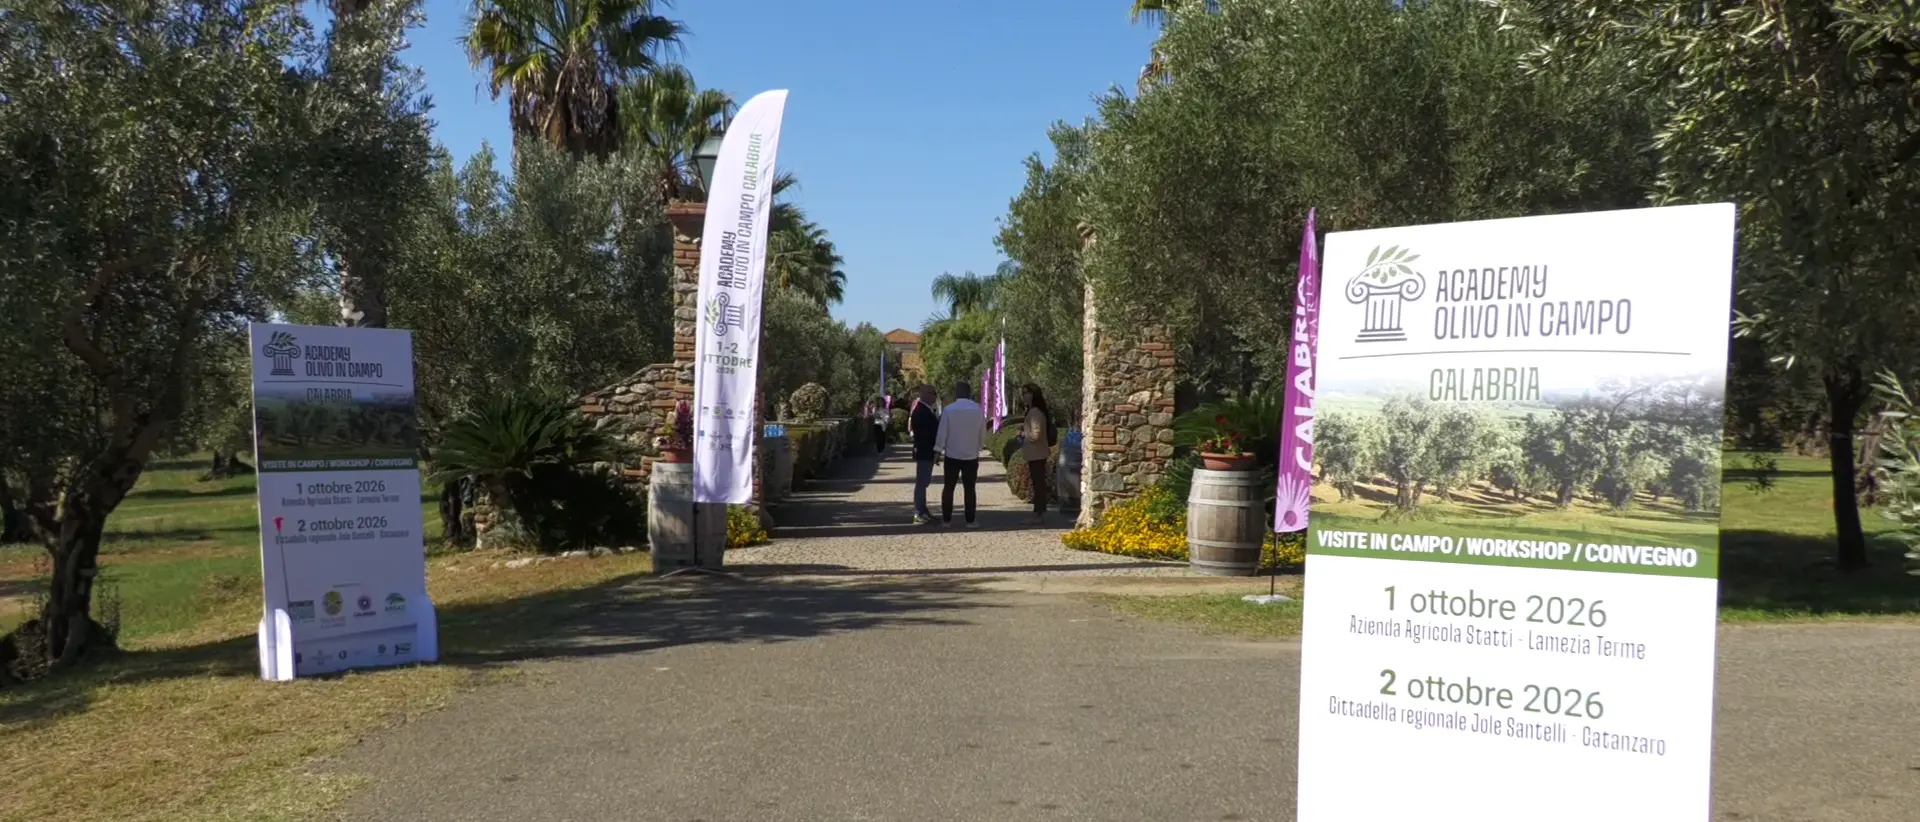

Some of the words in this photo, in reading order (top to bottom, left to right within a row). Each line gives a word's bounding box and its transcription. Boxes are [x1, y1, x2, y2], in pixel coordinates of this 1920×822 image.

[743, 133, 762, 191] CALABRIA
[738, 194, 756, 239] CAMPO
[717, 231, 737, 288] ACADEMY
[736, 240, 751, 254] IN
[734, 256, 750, 290] OLIVO
[1435, 264, 1548, 303] ACADEMY
[1434, 304, 1499, 340] OLIVO
[1506, 303, 1531, 337] IN
[1539, 298, 1632, 337] CAMPO
[304, 345, 351, 361] ACADEMY
[716, 341, 739, 354] 1-2
[305, 361, 334, 377] OLIVO
[335, 362, 347, 377] IN
[348, 362, 384, 378] CAMPO
[1429, 367, 1540, 401] CALABRIA
[306, 388, 353, 402] CALABRIA
[296, 483, 303, 494] 1
[307, 481, 353, 494] ottobre
[355, 480, 386, 493] 2026
[297, 519, 306, 532] 2
[310, 517, 354, 531] ottobre
[357, 516, 388, 529] 2026
[1317, 529, 1368, 550] VISITE
[1370, 532, 1388, 551] IN
[1390, 533, 1454, 554] CAMPO
[1455, 537, 1464, 556] /
[1466, 537, 1571, 561] WORKSHOP
[1572, 543, 1583, 563] /
[1584, 543, 1698, 568] CONVEGNO
[1384, 585, 1396, 611] 1
[1410, 589, 1516, 621] ottobre
[1526, 594, 1607, 628] 2026
[1349, 614, 1401, 638] Azienda
[1405, 619, 1462, 644] Agricola
[1466, 624, 1513, 648] Statti
[1528, 629, 1591, 655] Lamezia
[1596, 635, 1646, 660] Terme
[1379, 669, 1397, 696] 2
[1407, 676, 1513, 709] ottobre
[1523, 684, 1604, 720] 2026
[1329, 695, 1397, 722] Cittadella
[1401, 707, 1467, 730] regionale
[1471, 713, 1502, 736] Jole
[1506, 717, 1566, 743] Santelli
[1582, 726, 1666, 756] Catanzaro
